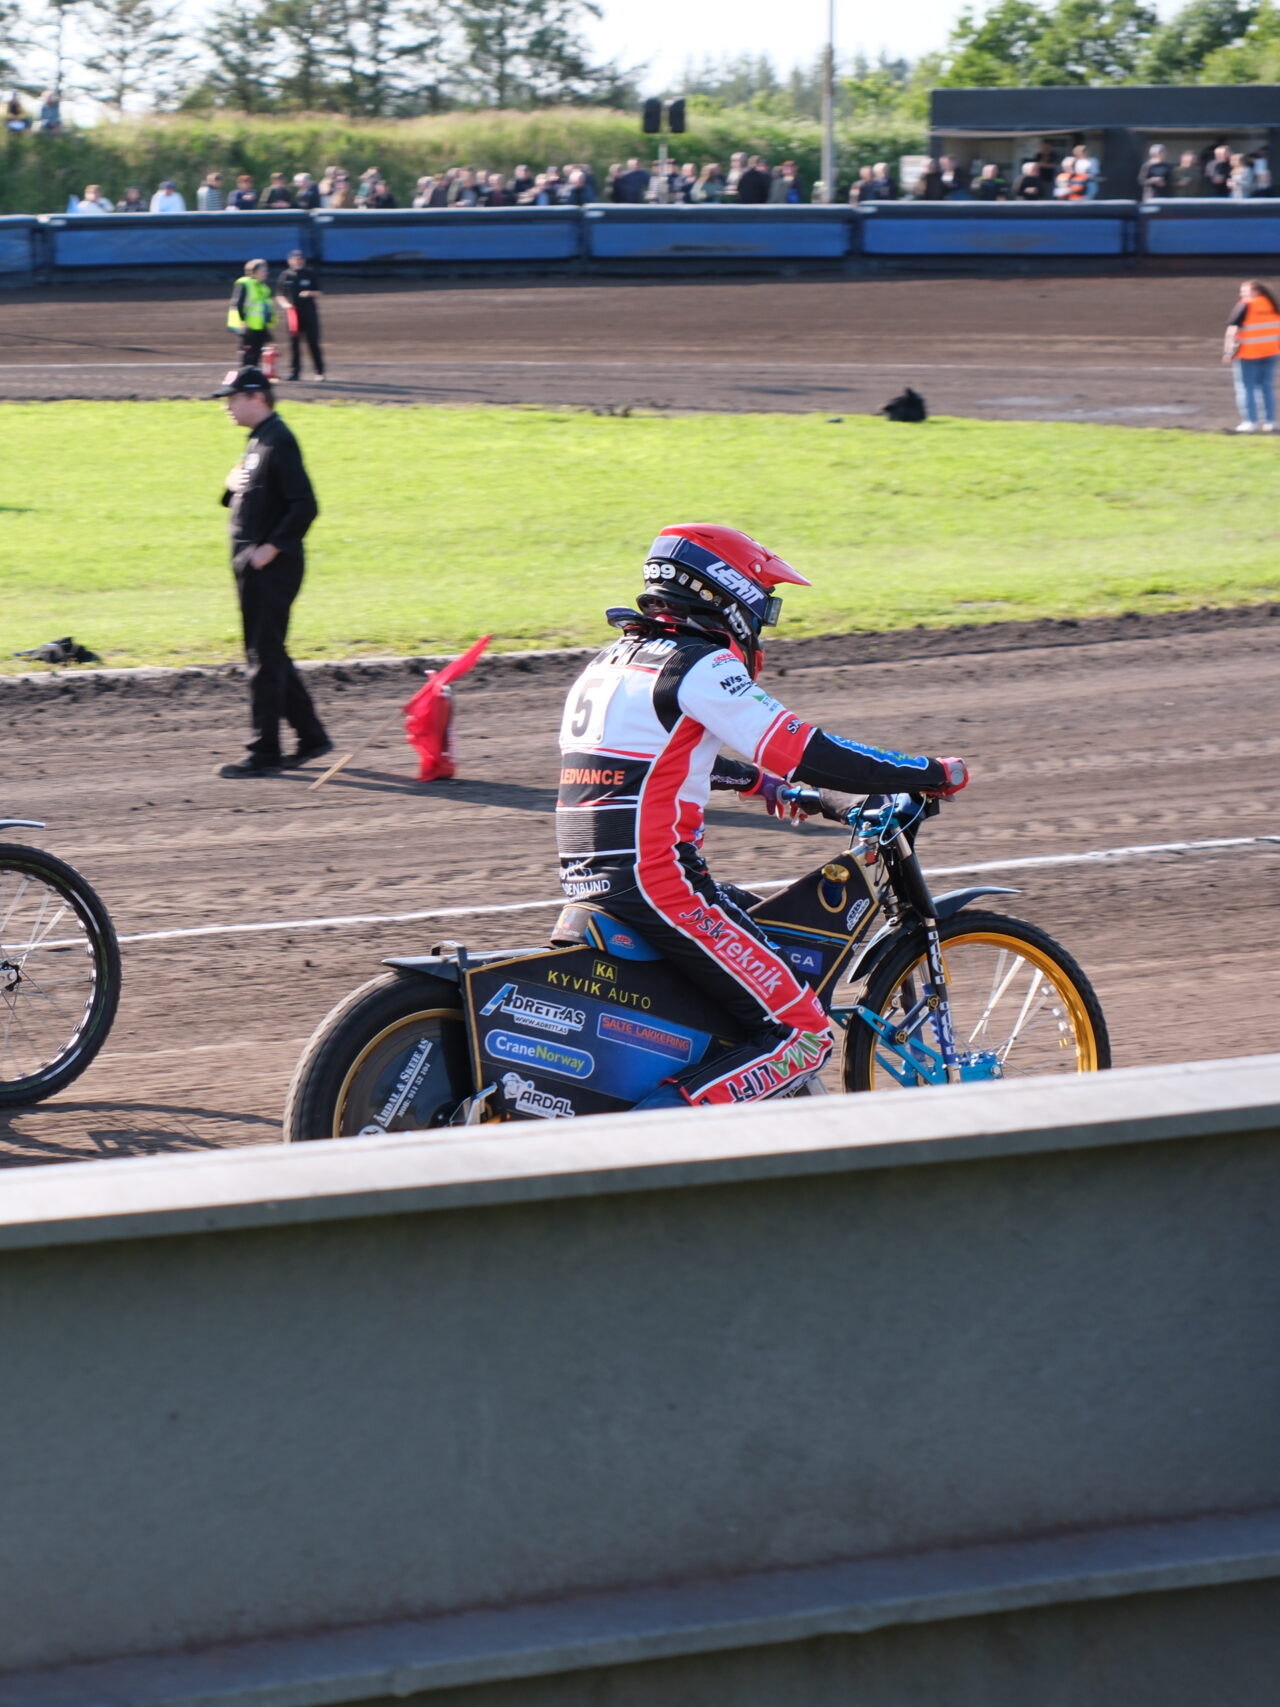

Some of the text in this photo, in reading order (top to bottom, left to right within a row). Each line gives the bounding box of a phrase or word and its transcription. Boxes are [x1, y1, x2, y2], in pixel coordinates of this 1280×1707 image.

[642, 563, 676, 580] 999
[706, 561, 766, 605] LEATT
[571, 678, 604, 738] 5
[560, 768, 625, 785] LEDVANCE
[595, 963, 615, 981] KA
[547, 970, 652, 1010] KYVIK AUTO
[602, 1016, 633, 1033] SALTE
[635, 1026, 690, 1051] LAKKERING
[495, 1036, 585, 1072] CraneNorway
